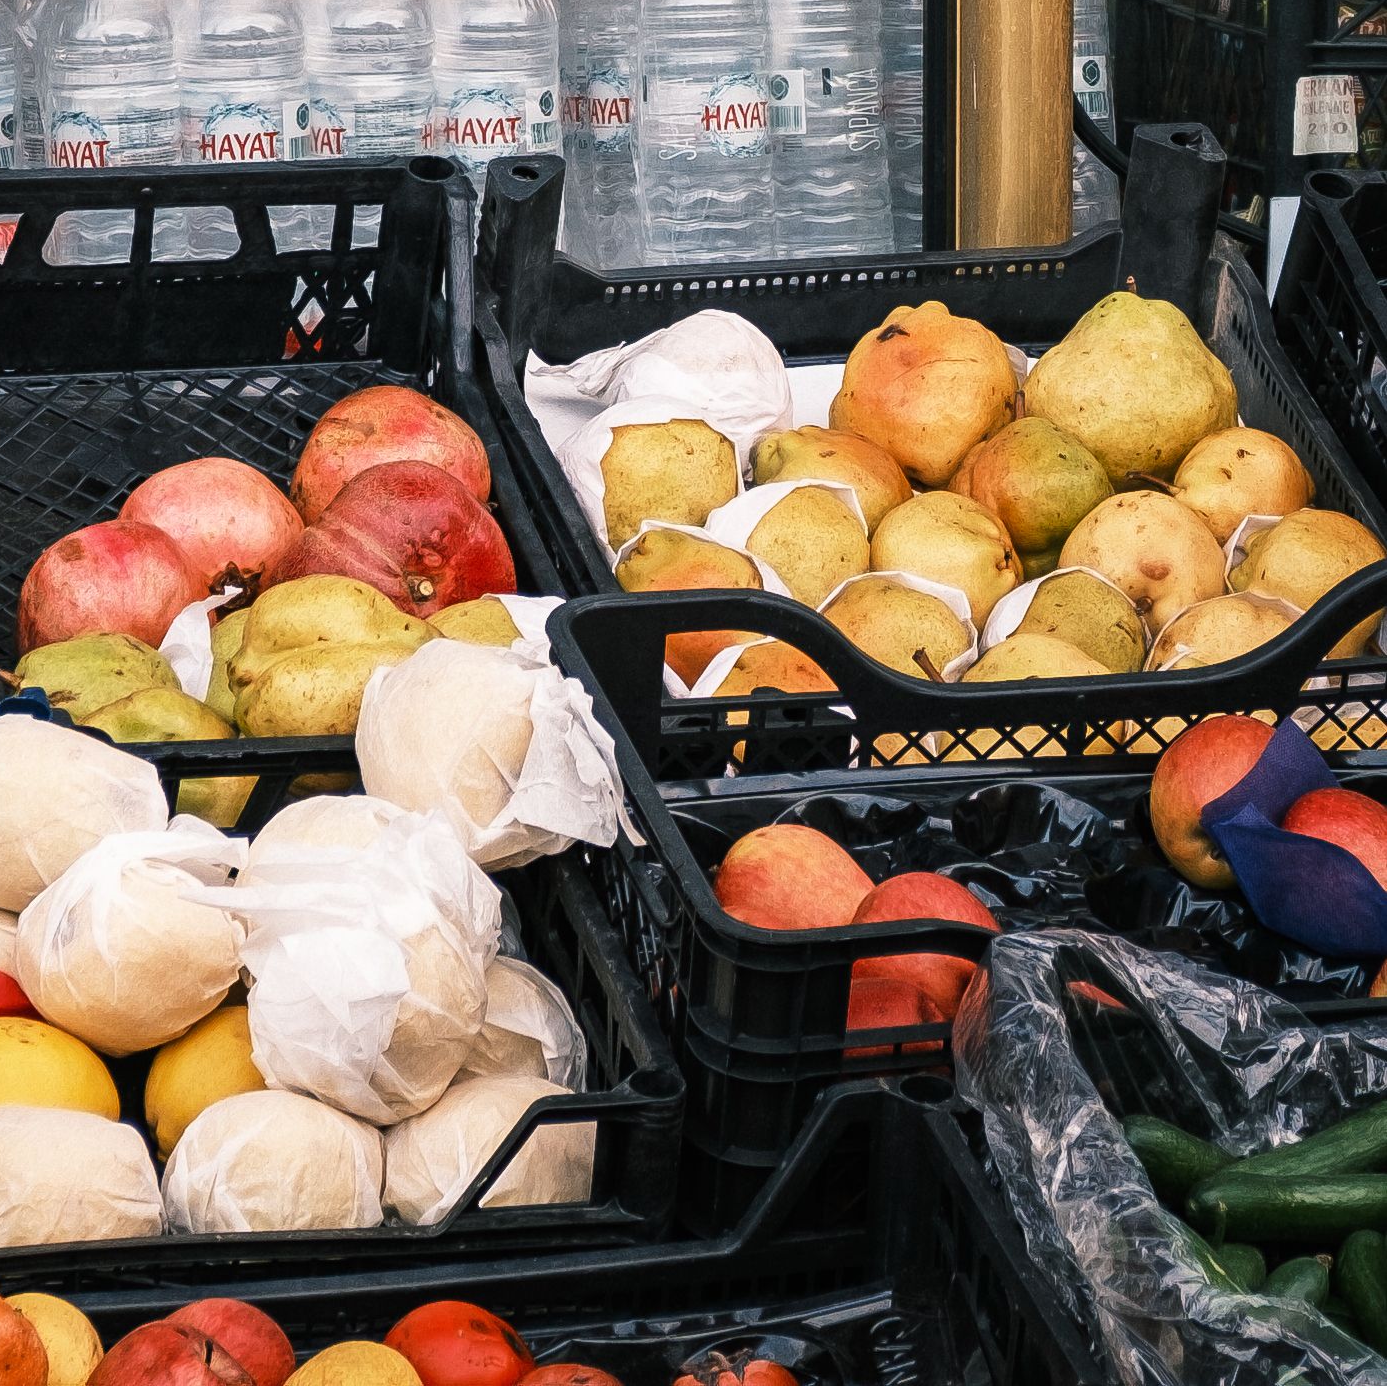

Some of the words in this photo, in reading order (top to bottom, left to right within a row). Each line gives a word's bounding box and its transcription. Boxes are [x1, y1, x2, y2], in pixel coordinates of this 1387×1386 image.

[700, 100, 769, 132] HAYAT
[848, 67, 883, 153] SAPANCA
[199, 130, 281, 161] HAYAT
[444, 116, 522, 145] HAYAT
